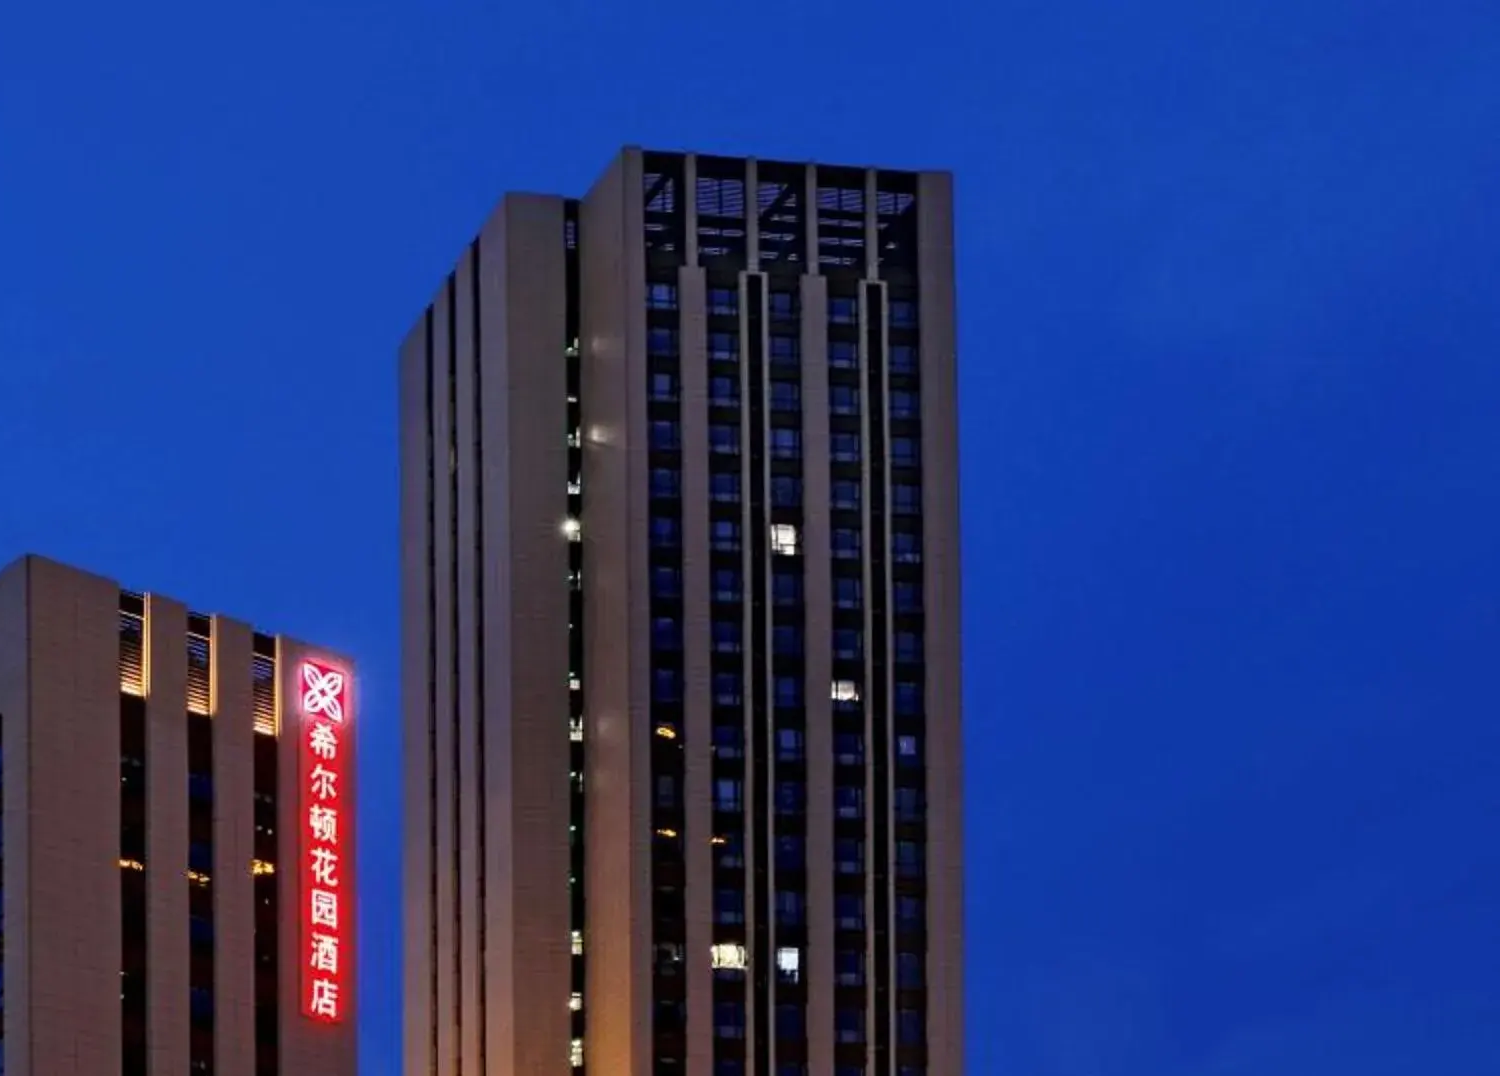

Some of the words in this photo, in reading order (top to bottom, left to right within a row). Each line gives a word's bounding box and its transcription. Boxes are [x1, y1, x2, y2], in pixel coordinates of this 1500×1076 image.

[308, 721, 339, 1018] 希尔顿花园酒店
